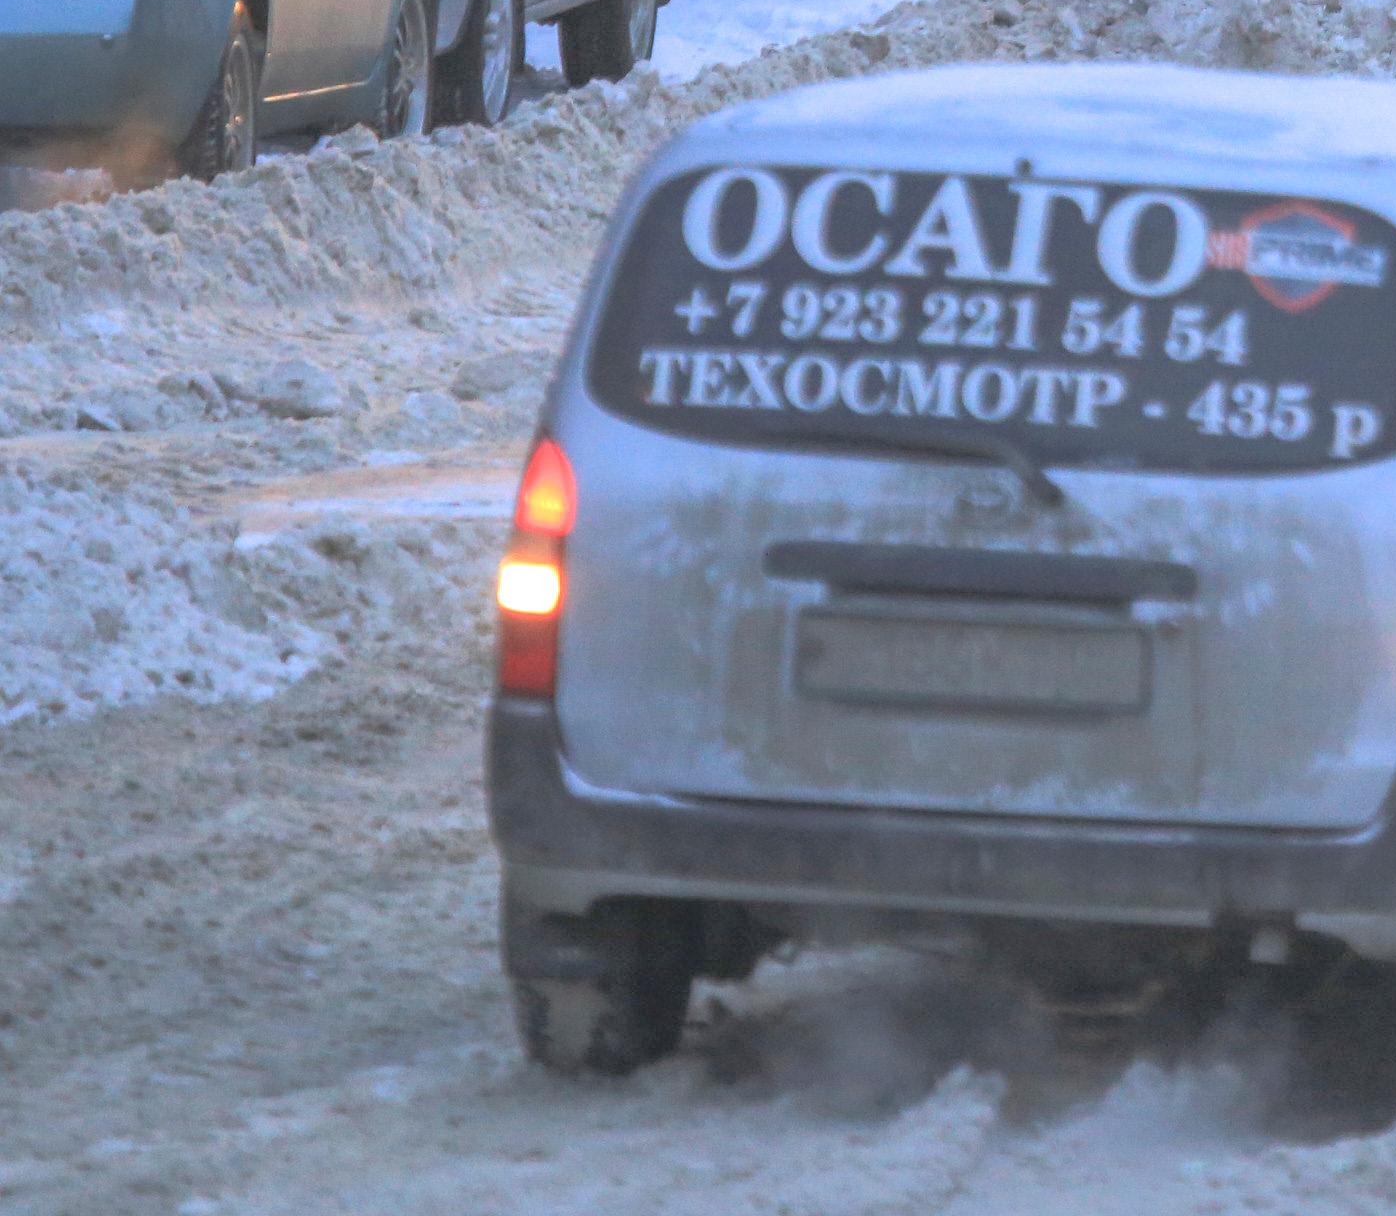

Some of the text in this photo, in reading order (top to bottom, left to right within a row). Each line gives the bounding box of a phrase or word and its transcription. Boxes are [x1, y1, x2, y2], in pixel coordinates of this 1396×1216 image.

[682, 167, 1207, 297] ОСАГО
[674, 283, 1248, 367] +7 923 221 54 54
[639, 349, 1128, 428] ТЕХОСМОТР
[1186, 380, 1313, 441] 435
[1329, 400, 1382, 459] р
